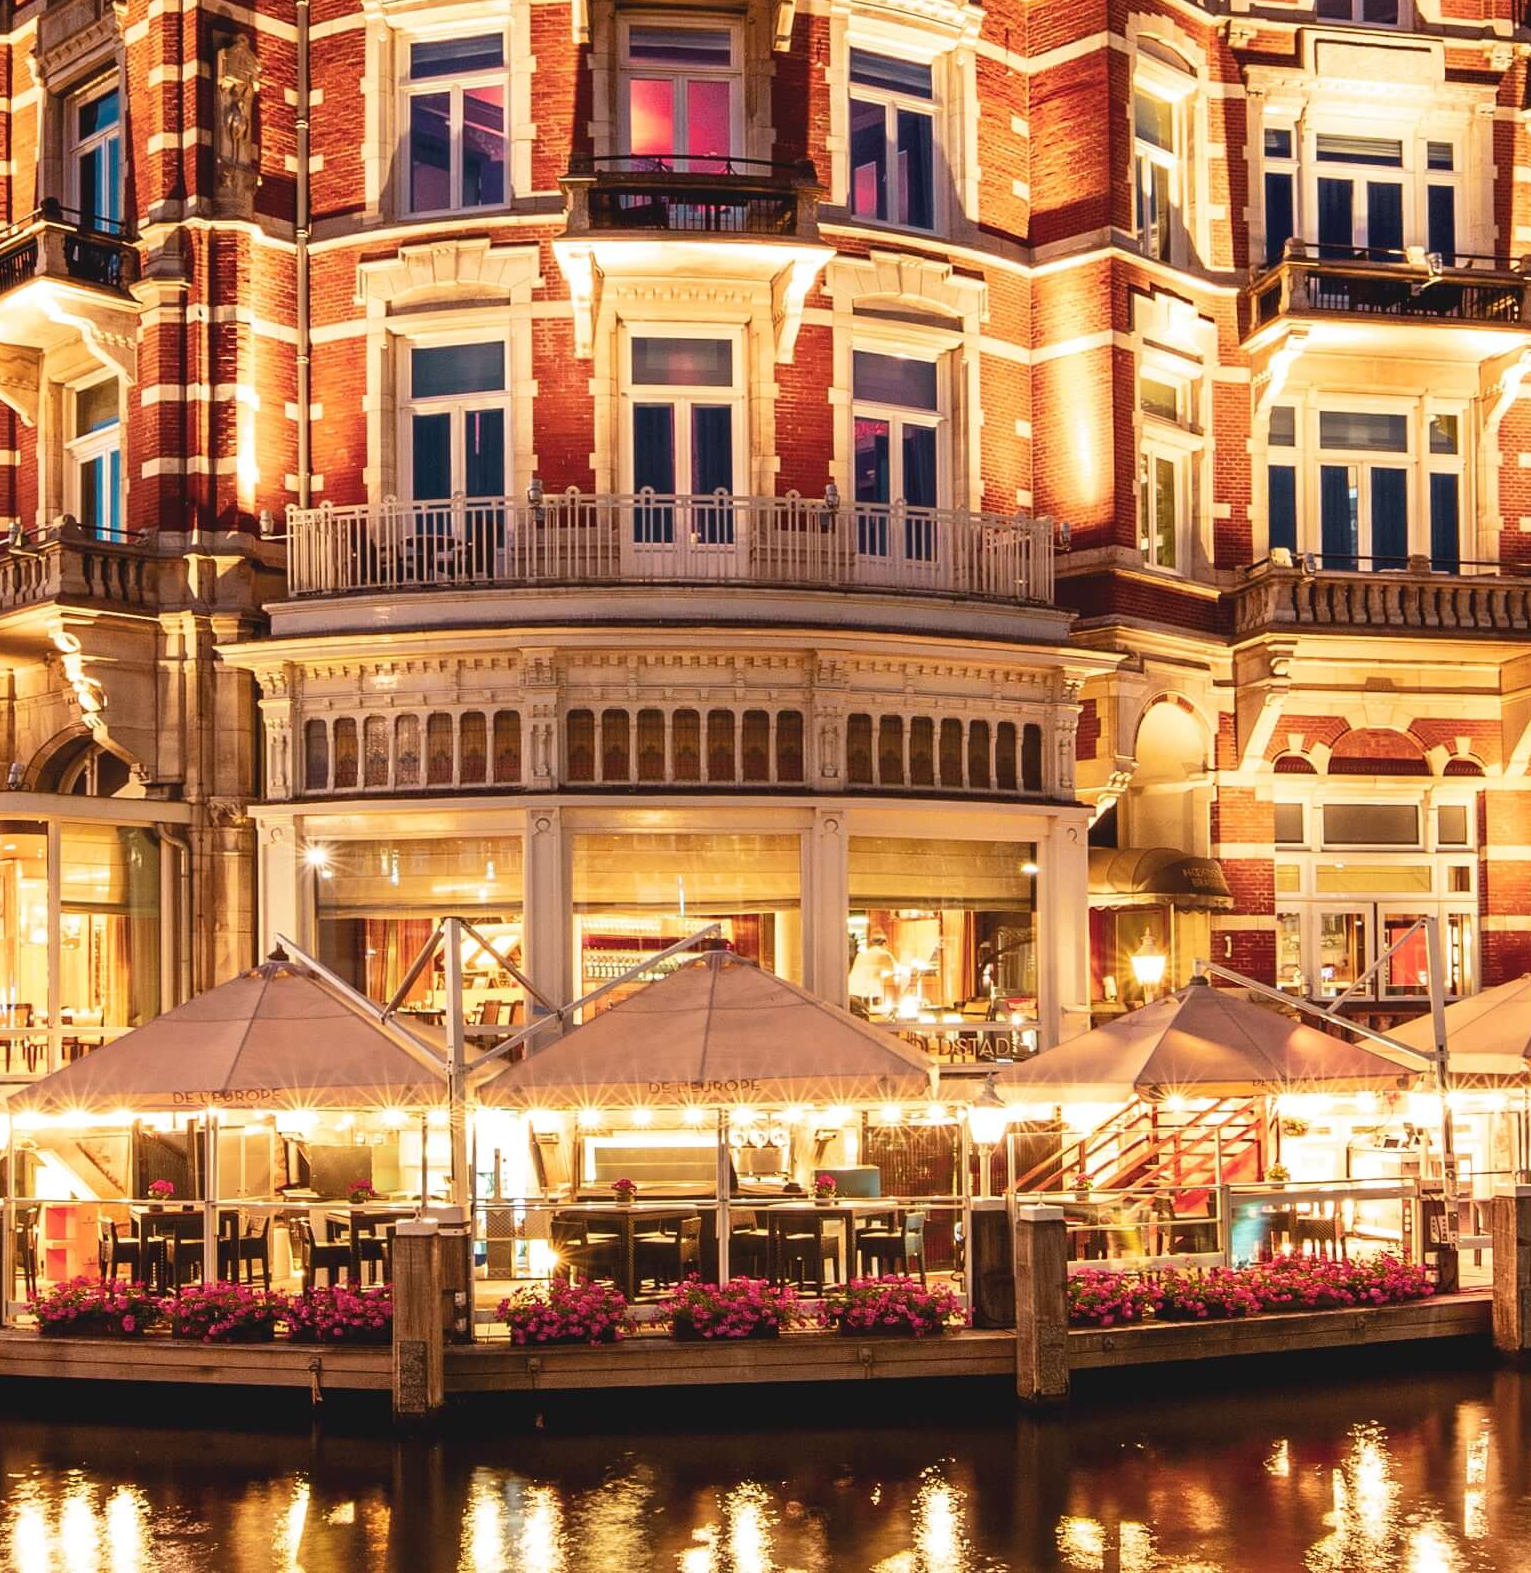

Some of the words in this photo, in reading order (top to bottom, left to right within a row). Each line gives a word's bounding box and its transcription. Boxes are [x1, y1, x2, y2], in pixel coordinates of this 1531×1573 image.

[649, 1081, 671, 1095] DE
[677, 1078, 761, 1094] L'EUROPE
[172, 1091, 195, 1104] DE
[200, 1087, 282, 1104] L'EUROPE
